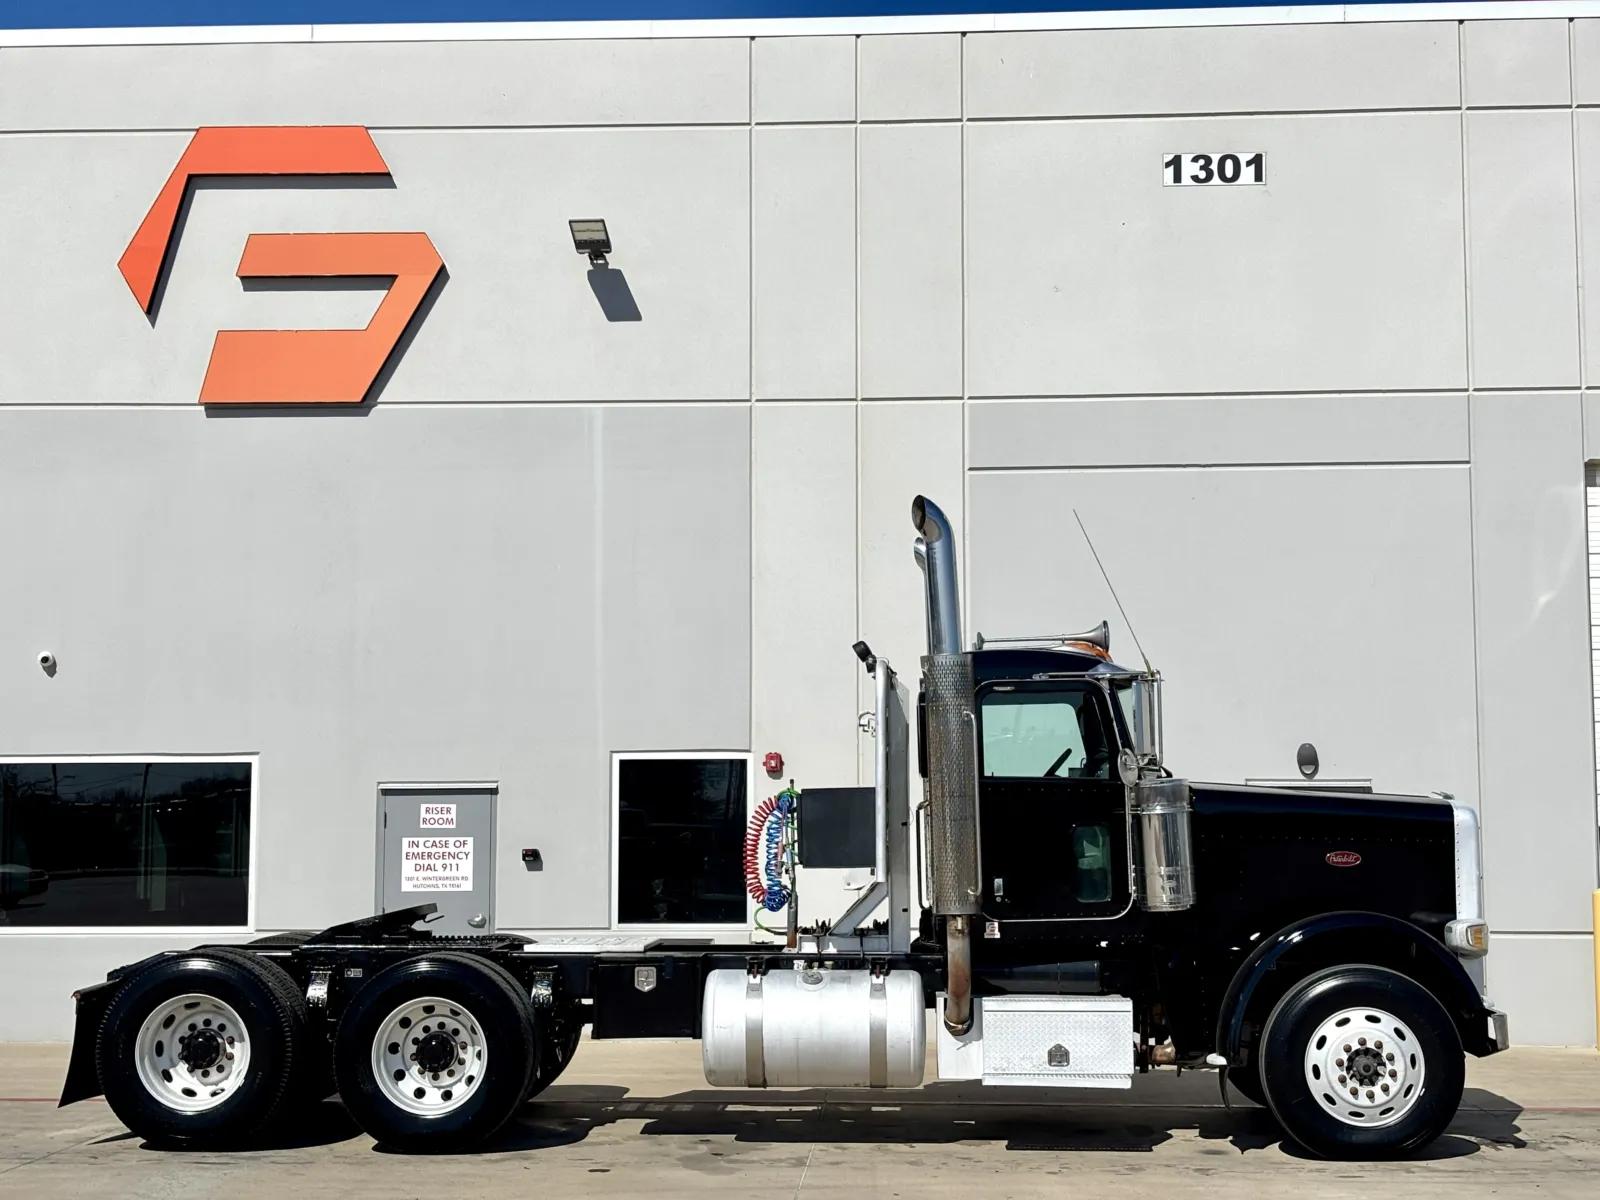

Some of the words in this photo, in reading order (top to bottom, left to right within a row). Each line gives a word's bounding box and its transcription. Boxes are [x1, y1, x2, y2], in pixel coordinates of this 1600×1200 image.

[1164, 153, 1263, 184] 1301
[425, 806, 452, 815] RISER
[422, 817, 454, 826] ROOM
[408, 840, 419, 849] IN
[423, 840, 450, 849] CASE
[453, 840, 468, 849] OF
[405, 851, 470, 860] EMERGENCY
[414, 863, 438, 872] DIAL
[441, 863, 460, 872] 911
